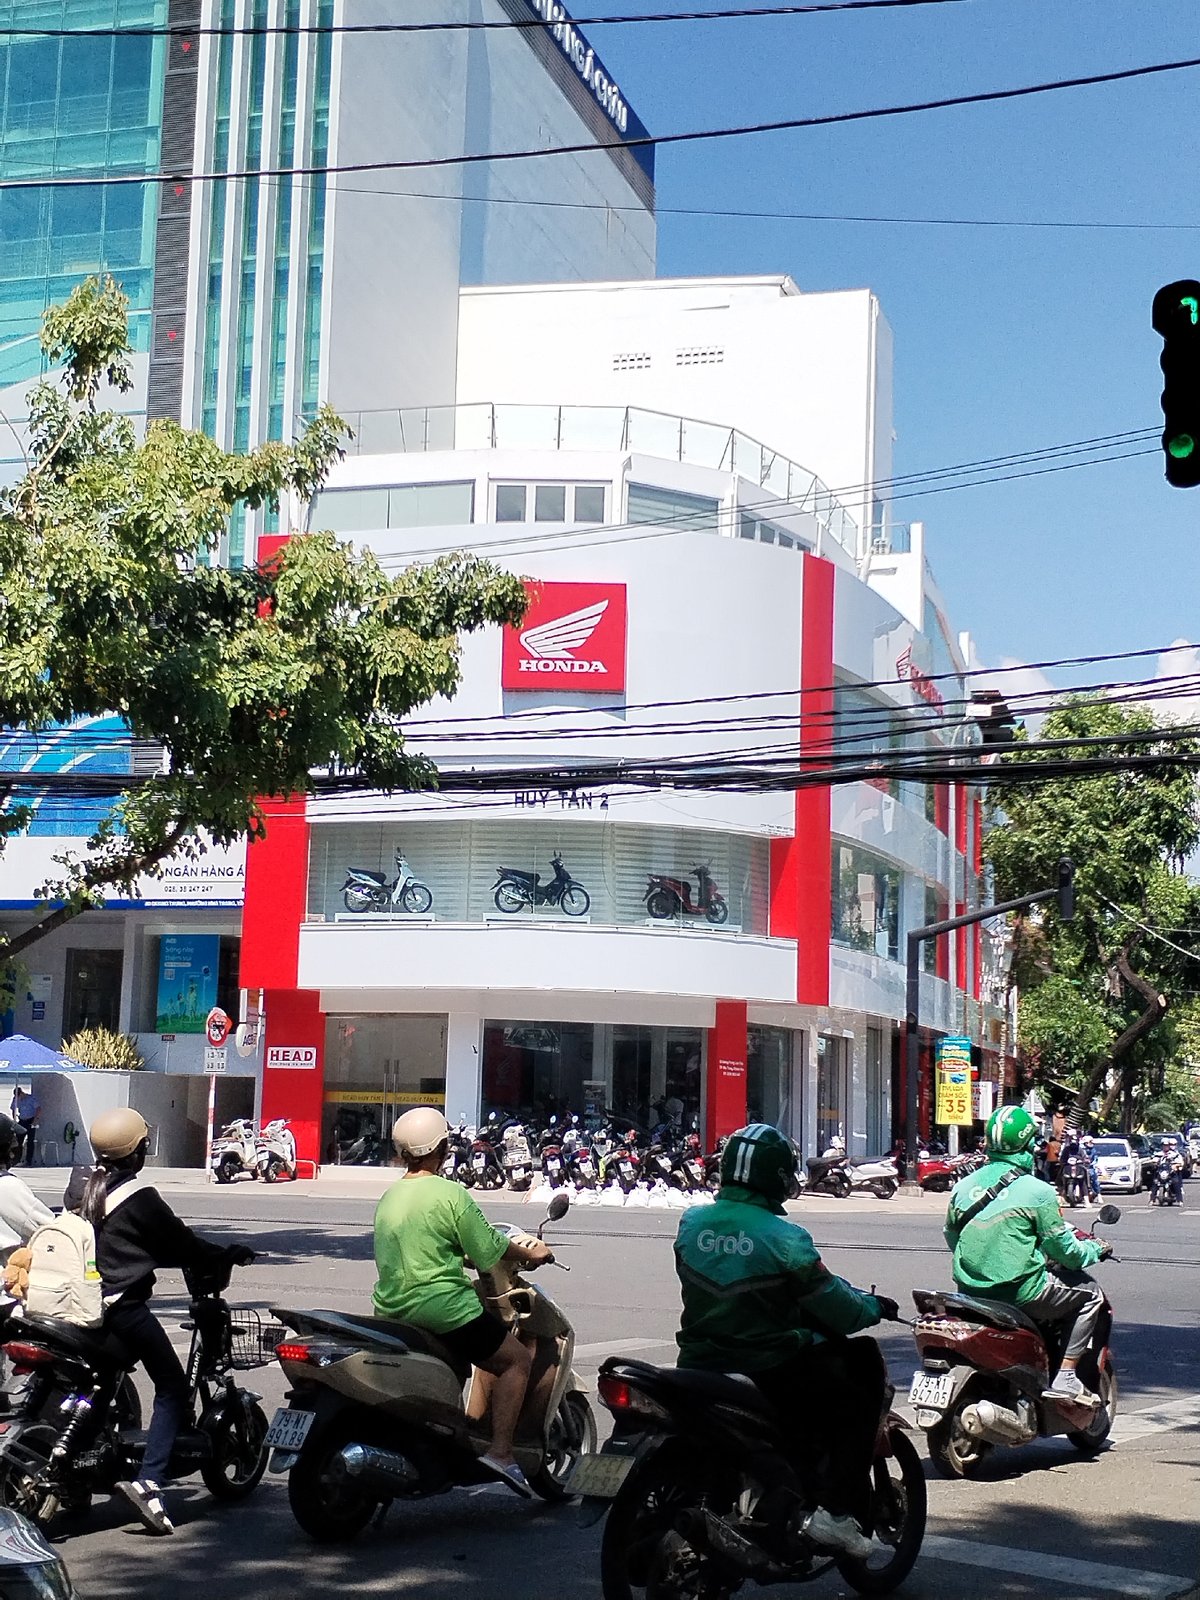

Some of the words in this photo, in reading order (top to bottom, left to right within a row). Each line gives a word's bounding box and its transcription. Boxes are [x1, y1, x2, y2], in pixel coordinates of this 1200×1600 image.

[518, 659, 608, 673] HONDA
[514, 790, 549, 808] HUY
[599, 792, 609, 810] 2
[164, 864, 198, 877] NGÂN
[200, 864, 234, 877] HÀNG
[270, 1050, 313, 1062] HEAD
[945, 1099, 966, 1113] 35
[697, 1229, 753, 1255] Grab
[266, 1428, 305, 1447] 991.89
